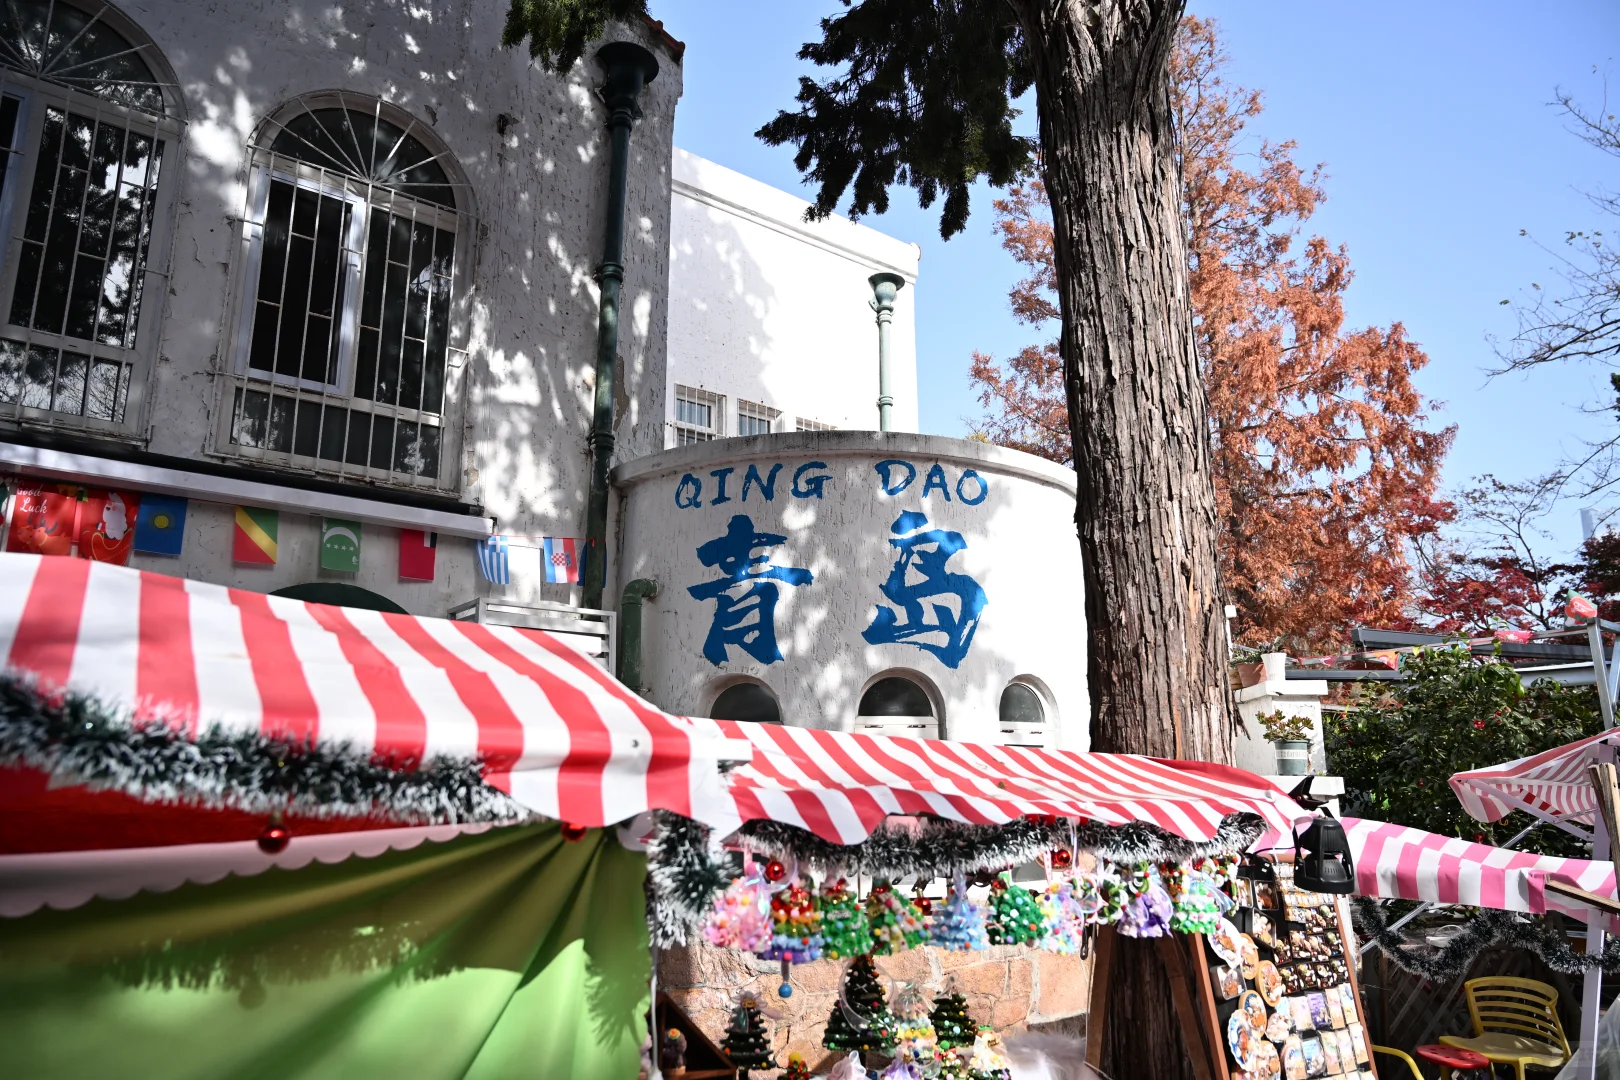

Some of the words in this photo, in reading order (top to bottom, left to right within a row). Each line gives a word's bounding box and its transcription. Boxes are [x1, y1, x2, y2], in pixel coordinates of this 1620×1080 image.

[17, 480, 43, 496] Good
[675, 461, 833, 509] QING
[875, 459, 988, 506] DAO
[19, 496, 47, 514] Luck
[686, 509, 989, 669] 青岛
